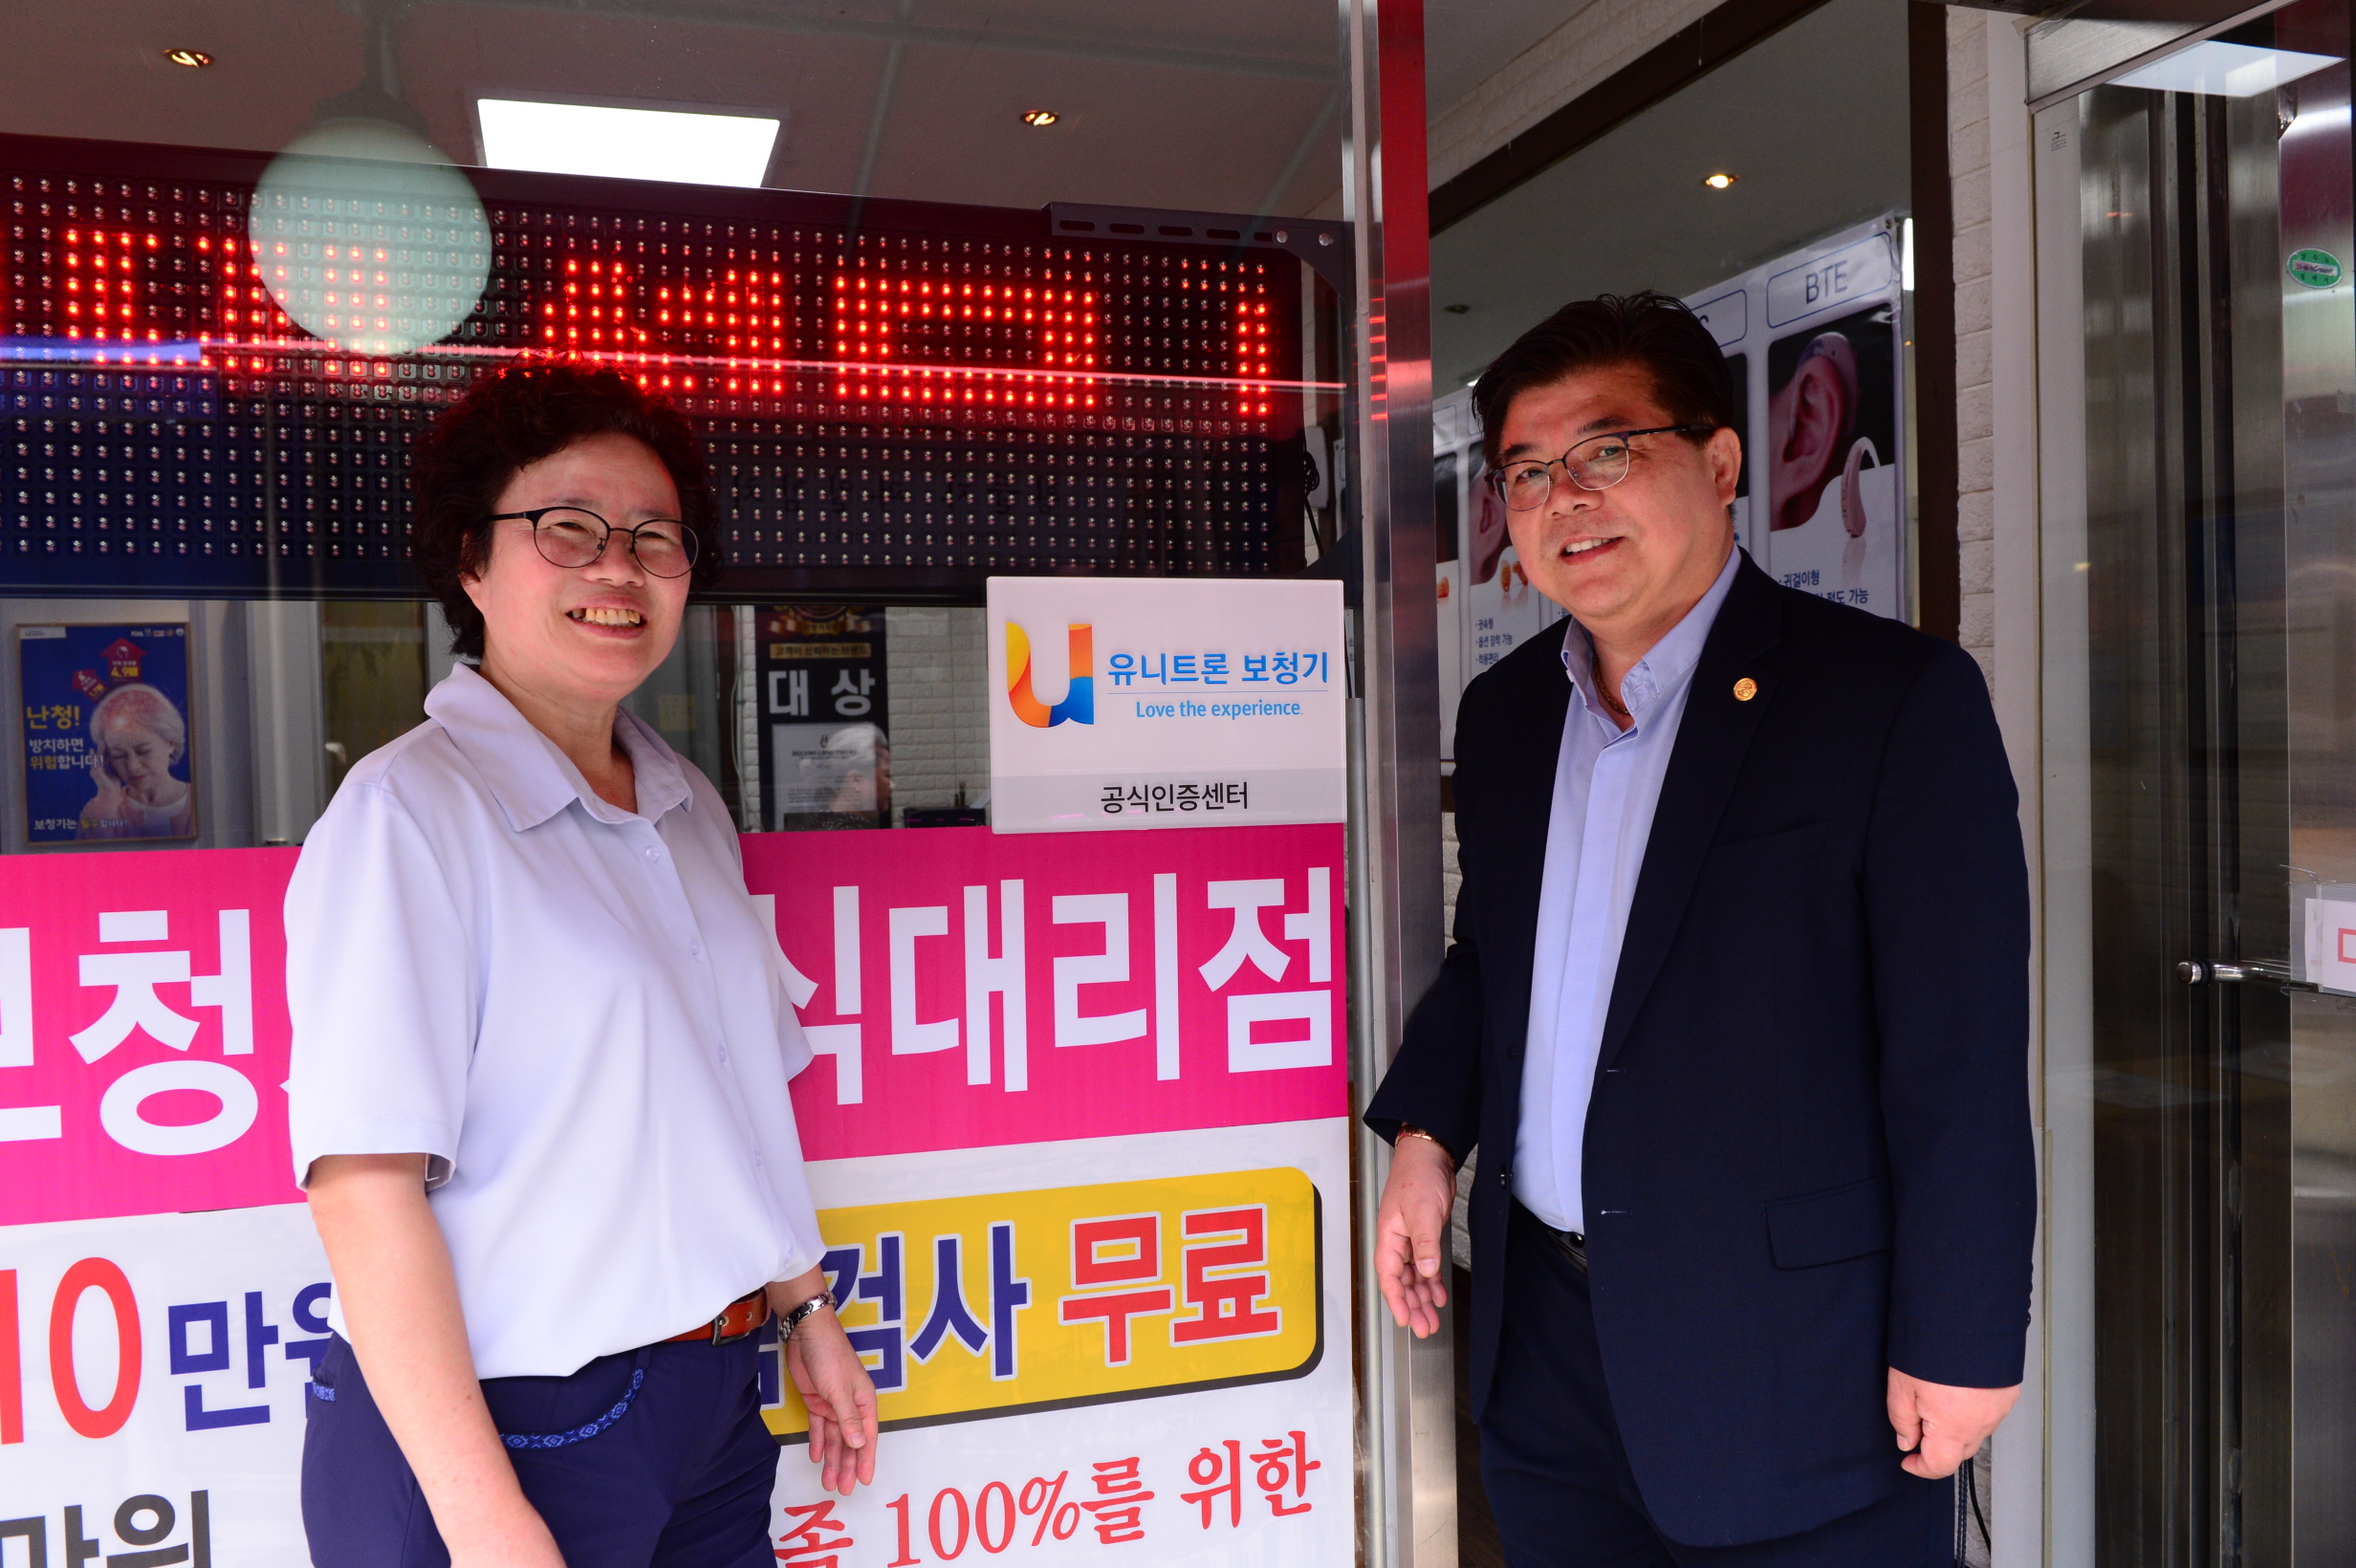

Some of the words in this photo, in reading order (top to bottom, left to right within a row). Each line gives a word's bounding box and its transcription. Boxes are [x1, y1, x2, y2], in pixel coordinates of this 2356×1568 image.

[1806, 260, 1848, 304] BTE
[1783, 570, 1820, 588] 귀걸이형
[1849, 588, 1868, 604] 가능
[1502, 633, 1513, 645] 가능
[1107, 652, 1231, 686] 유니트론
[1241, 651, 1328, 685] 보청기
[27, 706, 80, 730] 난청!
[1136, 701, 1175, 718] Love
[1179, 700, 1207, 717] the
[29, 738, 84, 753] 방치하면
[31, 754, 104, 770] 위험합니다!
[1101, 782, 1248, 814] 공식인증센터
[34, 818, 77, 830] 보청기는
[1061, 1207, 1279, 1364] 무료
[885, 1456, 1155, 1568] 100%를
[1181, 1430, 1321, 1530] 위한
